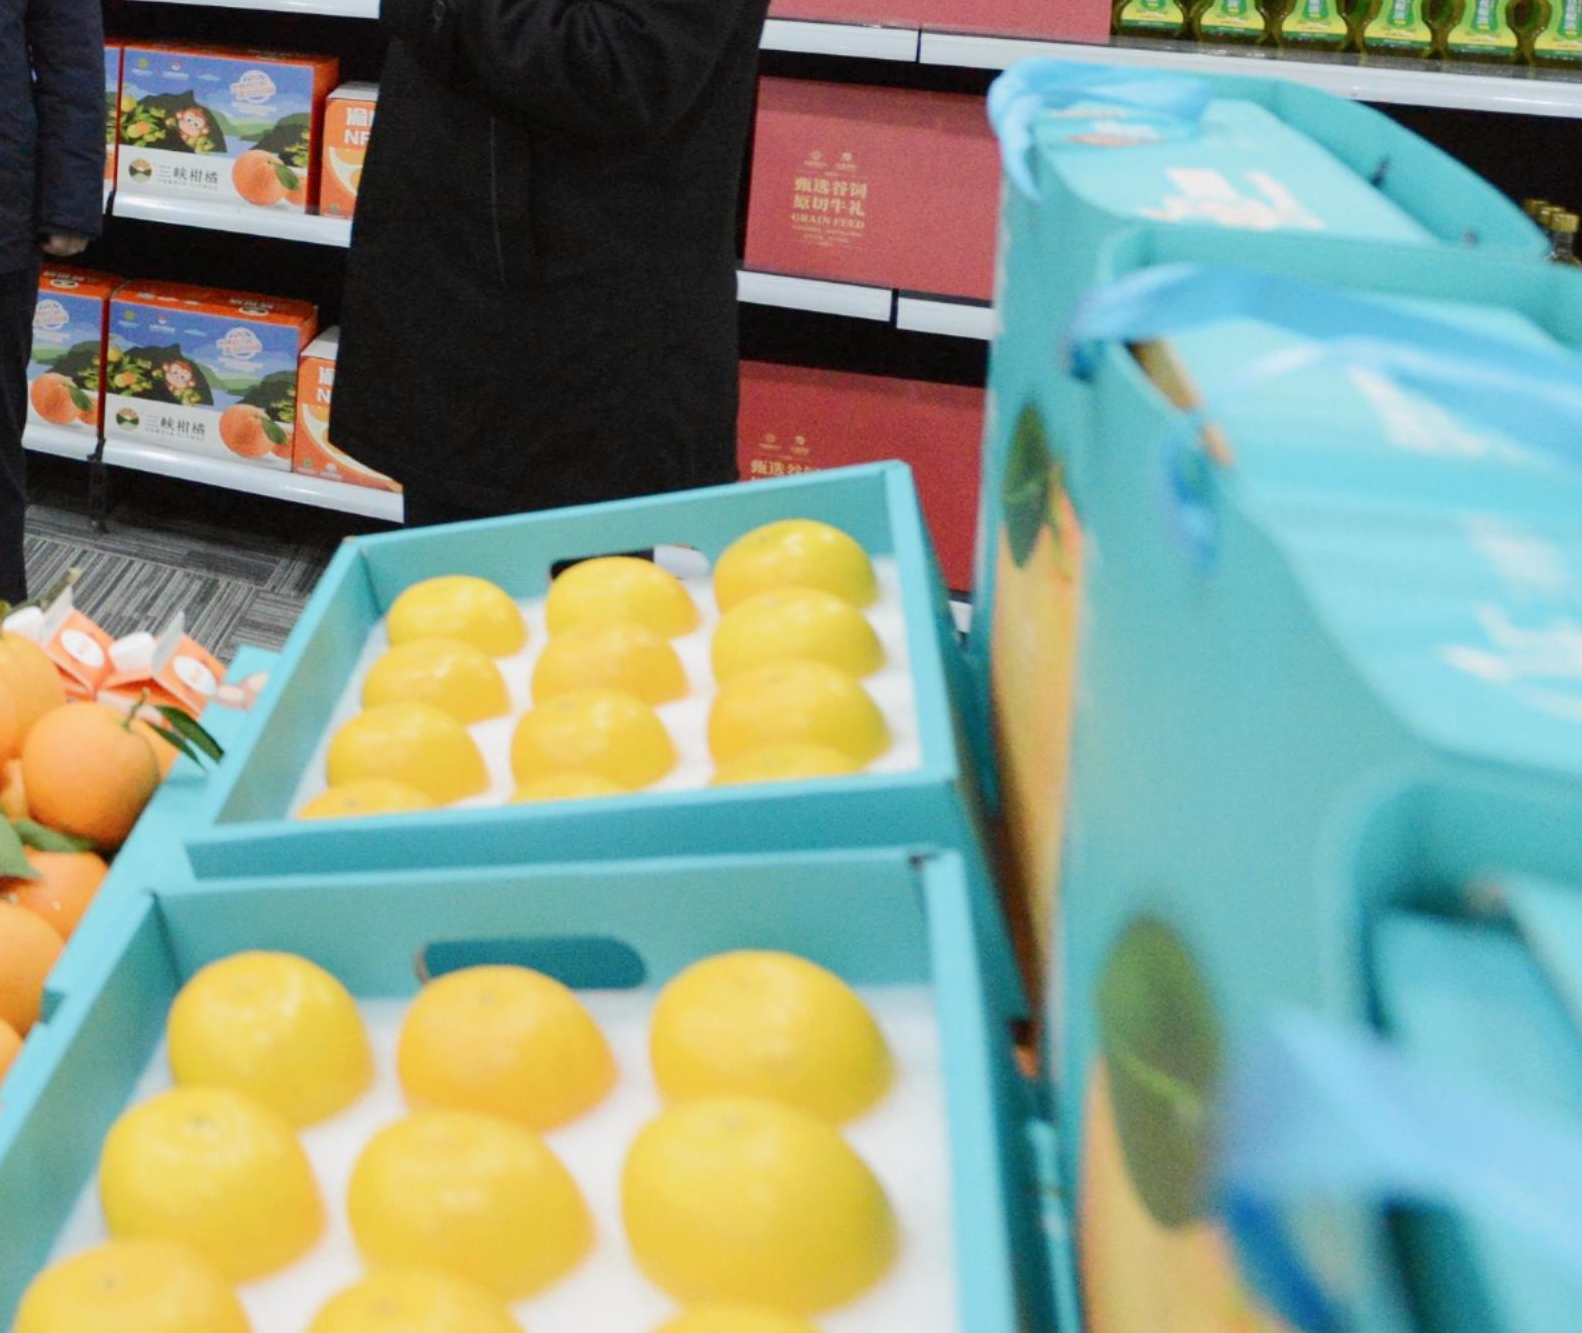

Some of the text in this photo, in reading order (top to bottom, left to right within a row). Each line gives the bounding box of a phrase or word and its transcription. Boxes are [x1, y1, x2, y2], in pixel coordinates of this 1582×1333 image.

[159, 165, 217, 184] 三峡柑橘
[147, 414, 205, 435] 三峡柑橘
[751, 460, 811, 475] 甄选谷
